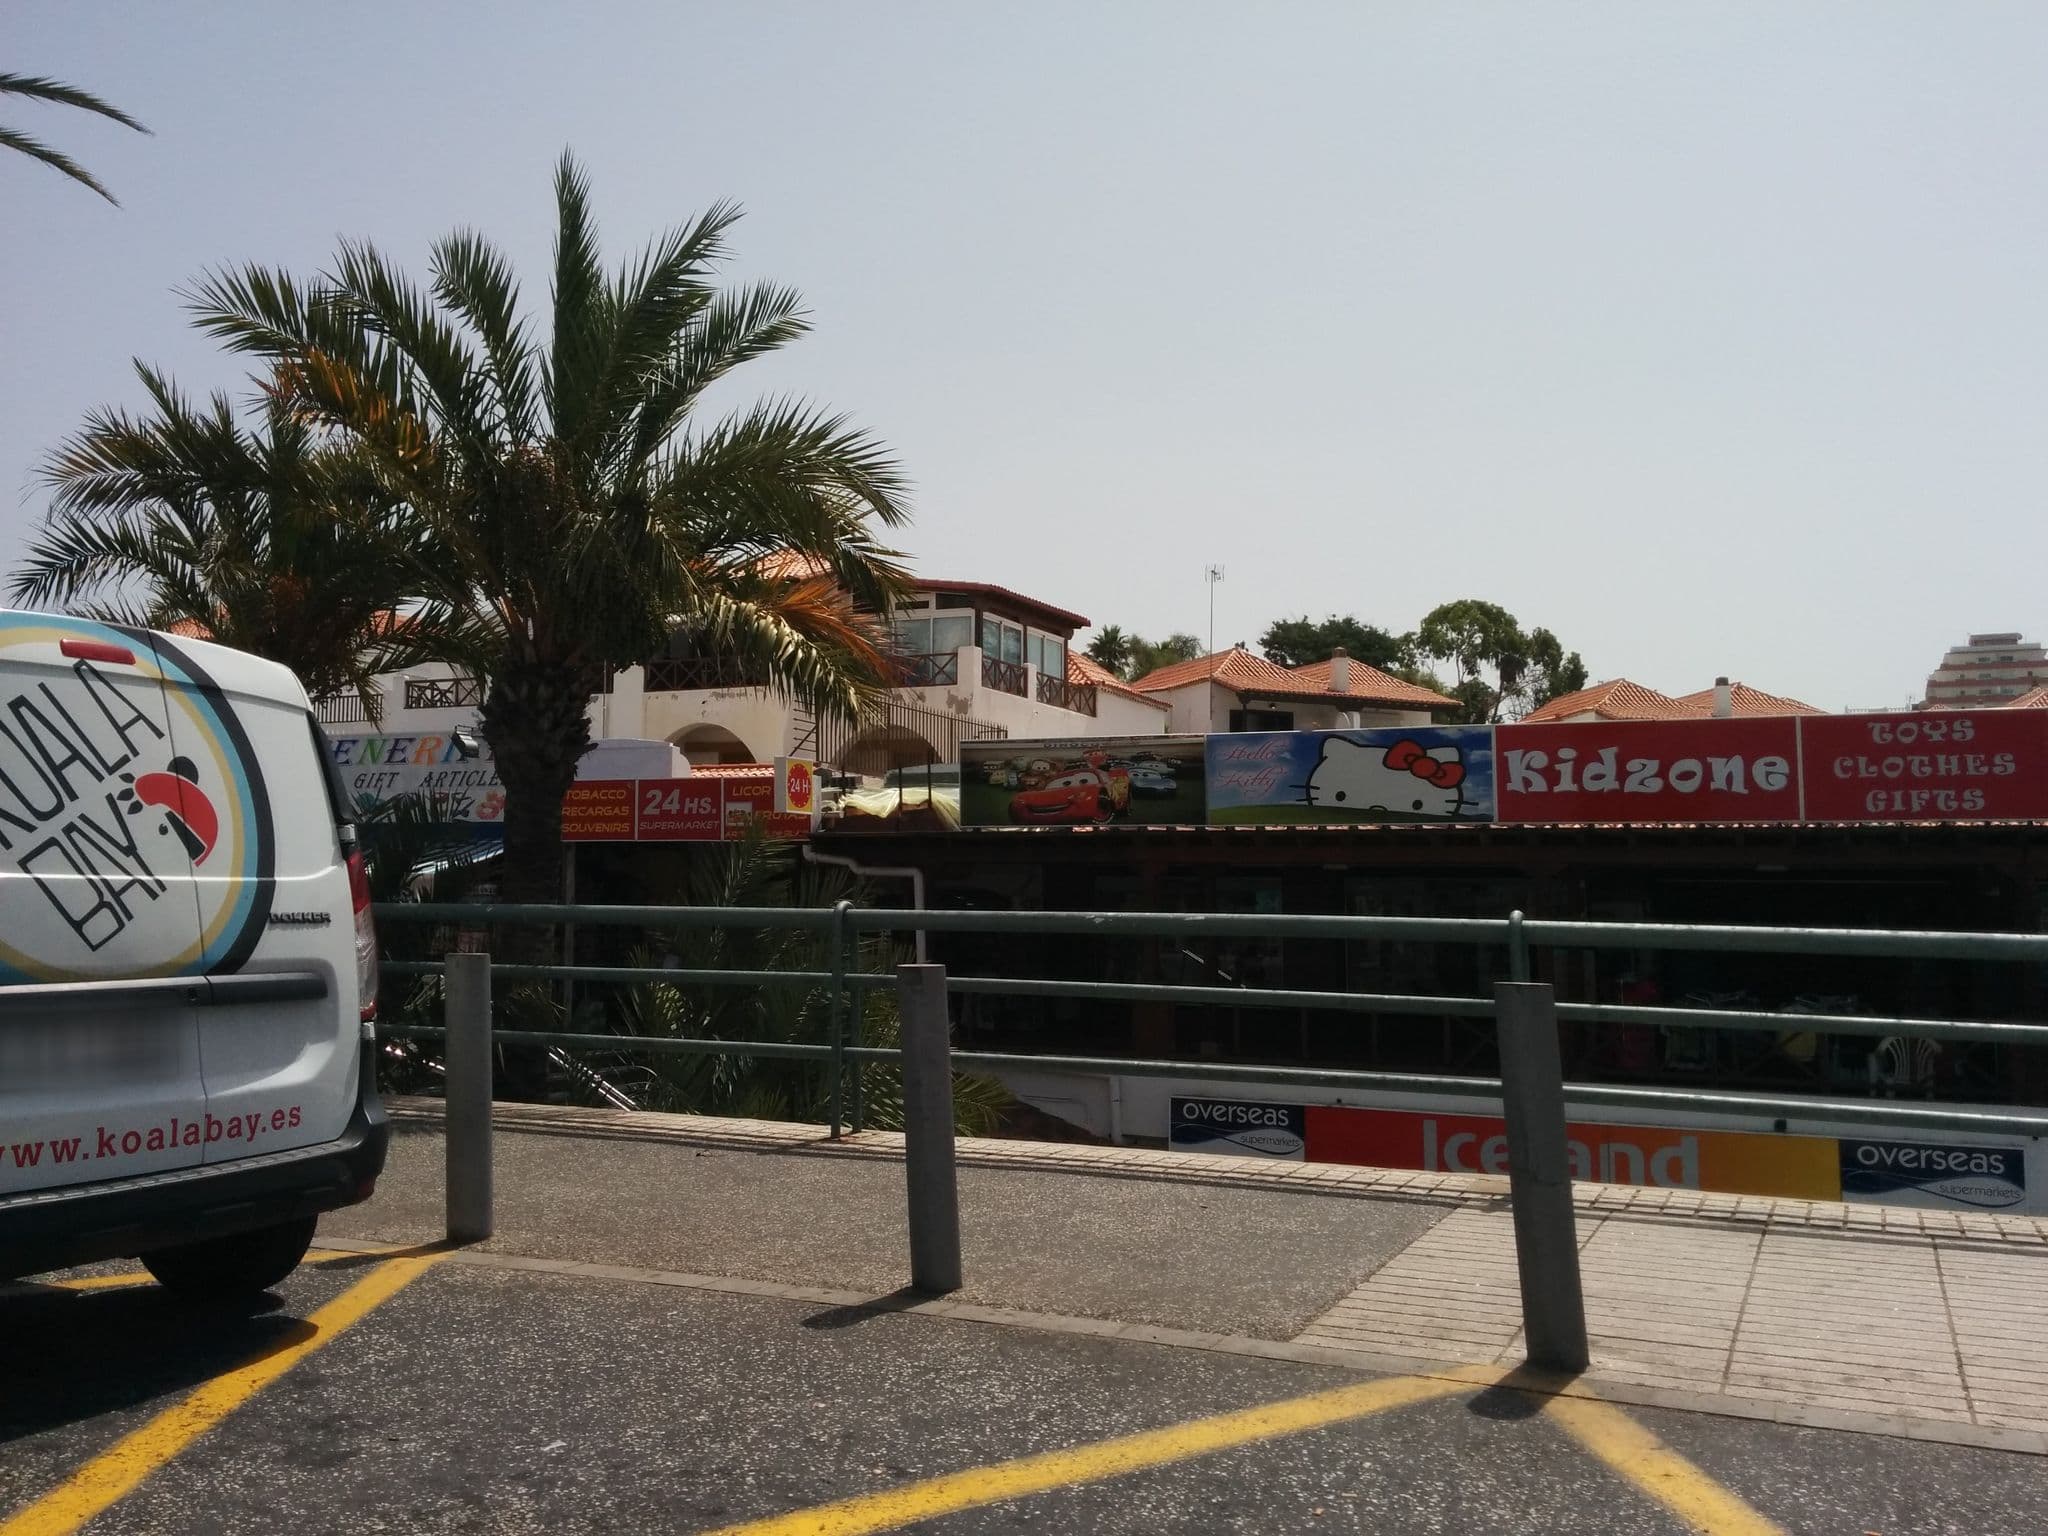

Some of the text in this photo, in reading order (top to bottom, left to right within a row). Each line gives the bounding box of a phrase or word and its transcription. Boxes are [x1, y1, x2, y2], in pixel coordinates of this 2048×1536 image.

[1867, 719, 1976, 744] TOYS
[1222, 740, 1282, 761] Hello
[1503, 745, 1790, 795] Kidzone
[1832, 752, 2017, 778] CLOTHES
[353, 772, 400, 789] GIFT
[790, 778, 809, 793] 24 H
[1219, 766, 1286, 793] Kitty
[565, 788, 626, 800] TOBACCO
[731, 785, 772, 797] LICOR
[1864, 788, 1986, 812] GIFTS
[561, 805, 630, 817] RECARGAS
[643, 788, 717, 816] 24 HS.
[561, 822, 630, 833] SOUVENIRS
[639, 820, 720, 831] SUPERMARKET
[17, 793, 167, 952] BAY
[268, 912, 331, 924] DOKKER
[1182, 1102, 1289, 1126] overseas
[1240, 1134, 1300, 1147] supermarkets
[1422, 1119, 1698, 1190] Iceand
[1856, 1145, 2006, 1174] overseas
[1938, 1183, 2021, 1200] supermarkets
